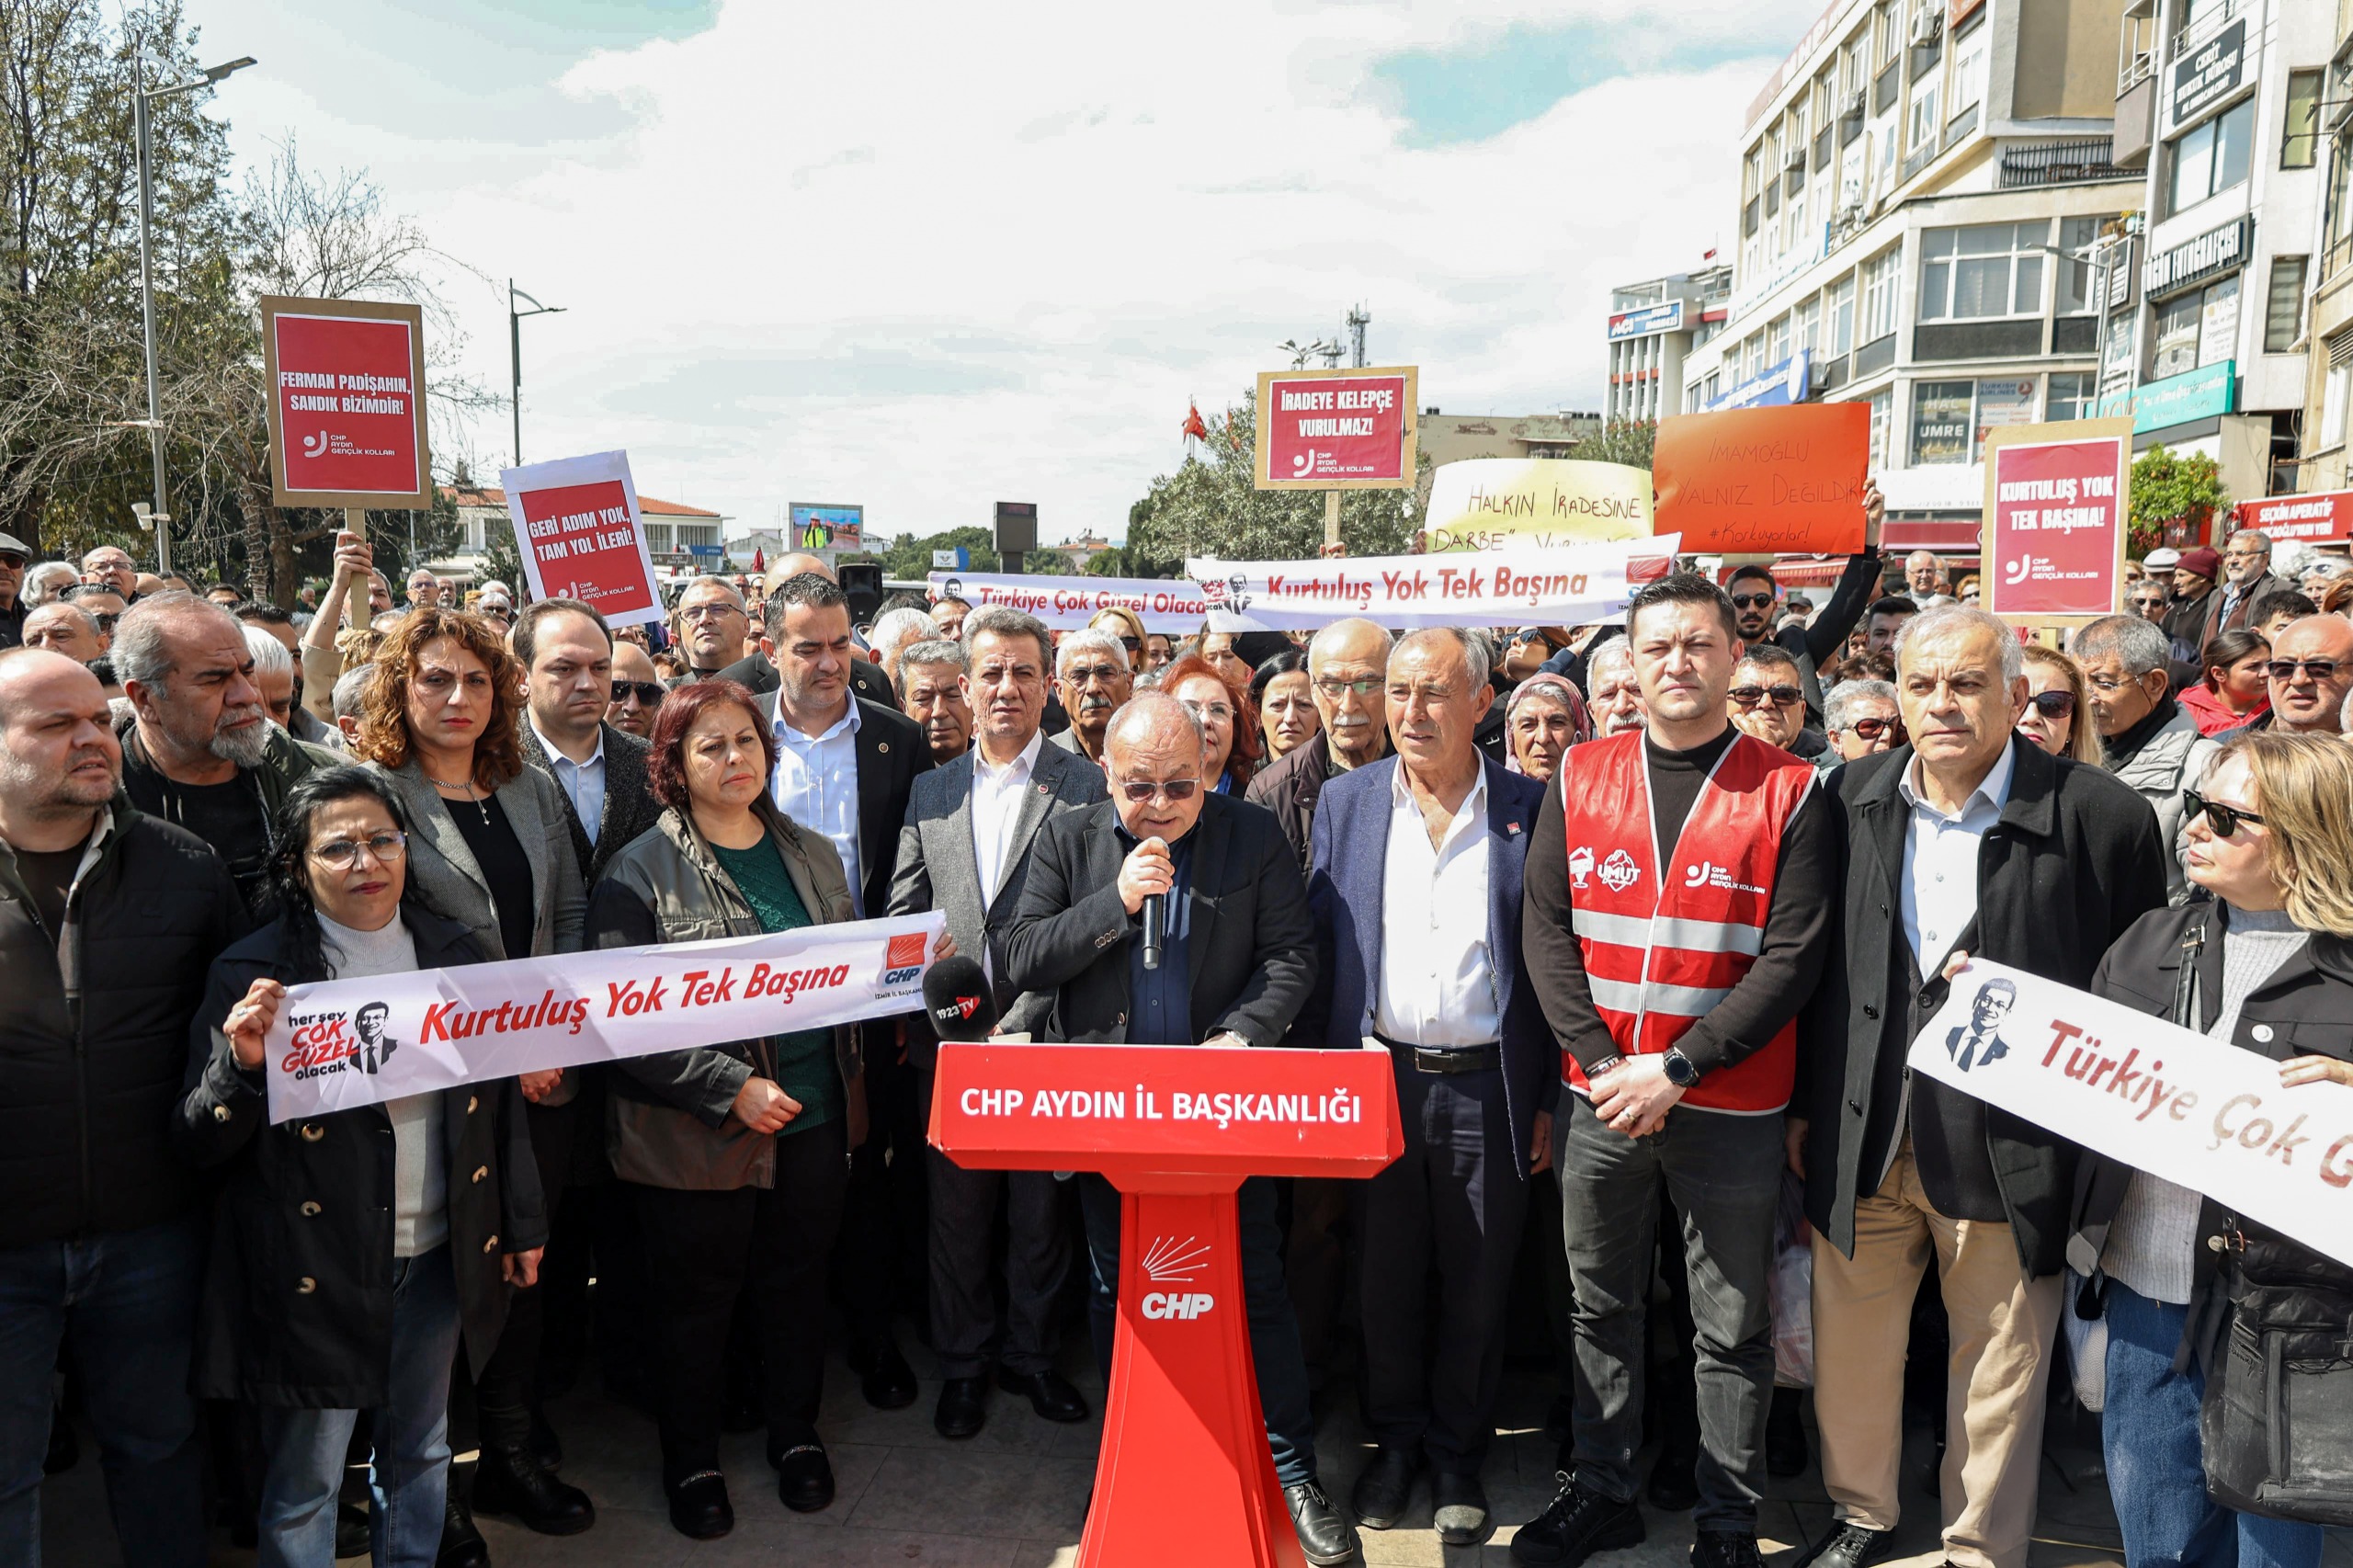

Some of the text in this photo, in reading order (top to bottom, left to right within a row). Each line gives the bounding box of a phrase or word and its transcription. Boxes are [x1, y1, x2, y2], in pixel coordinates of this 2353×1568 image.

[2176, 73, 2204, 104] HUKUK
[2205, 48, 2238, 85] BÜROSU
[280, 371, 412, 396] FERMAN PADİŞAHIN,
[290, 394, 404, 415] SANDIK BİZİMDİR!
[1281, 390, 1393, 414] İRADEYE KELEPÇE
[1299, 417, 1373, 437] VURULMAZ!
[1919, 425, 1964, 437] UMRE
[1316, 465, 1346, 473] GENÇLİK
[1468, 481, 1641, 519] HALKIN İRADESİNE
[1675, 476, 1754, 506] YALNIZ
[1999, 475, 2114, 506] KURTULUŞ YOK
[529, 506, 631, 539] GERİ ADIM YOK,
[2010, 506, 2106, 535] TEK BAŞINA!
[2258, 497, 2334, 526] SEÇKİN APERATİF
[2315, 517, 2334, 536] YERİ
[537, 527, 634, 562] TAM YOL İLERİ!
[1267, 572, 1373, 611] Kurtuluş
[1381, 569, 1429, 601] Yok
[1437, 567, 1484, 600] Tek
[1493, 566, 1588, 607] Başına
[2031, 572, 2064, 581] GENÇLİK
[582, 585, 635, 601] GENÇLİK KOLLARI
[979, 586, 1207, 616] Türkiye Çok Güzel Olaca
[1597, 864, 1642, 881] UMUT
[1711, 873, 1732, 881] AYDIN
[1710, 880, 1766, 894] GENÇLİK KOLLARI
[884, 967, 921, 984] CHP
[419, 962, 850, 1045] Kurtuluş Yok Tek Başına
[875, 991, 892, 1000] İZMİR
[288, 1011, 347, 1028] her şey
[936, 997, 974, 1020] 1923 TV
[291, 1018, 347, 1051] ÇOK
[281, 1036, 358, 1073] GÜZEL
[295, 1060, 347, 1081] olacak
[2040, 1018, 2199, 1122] Türkiye
[2205, 1093, 2312, 1167] Çok
[961, 1083, 1361, 1131] CHP AYDIN İL BAŞKANLIĞI
[1142, 1291, 1214, 1320] CHP
